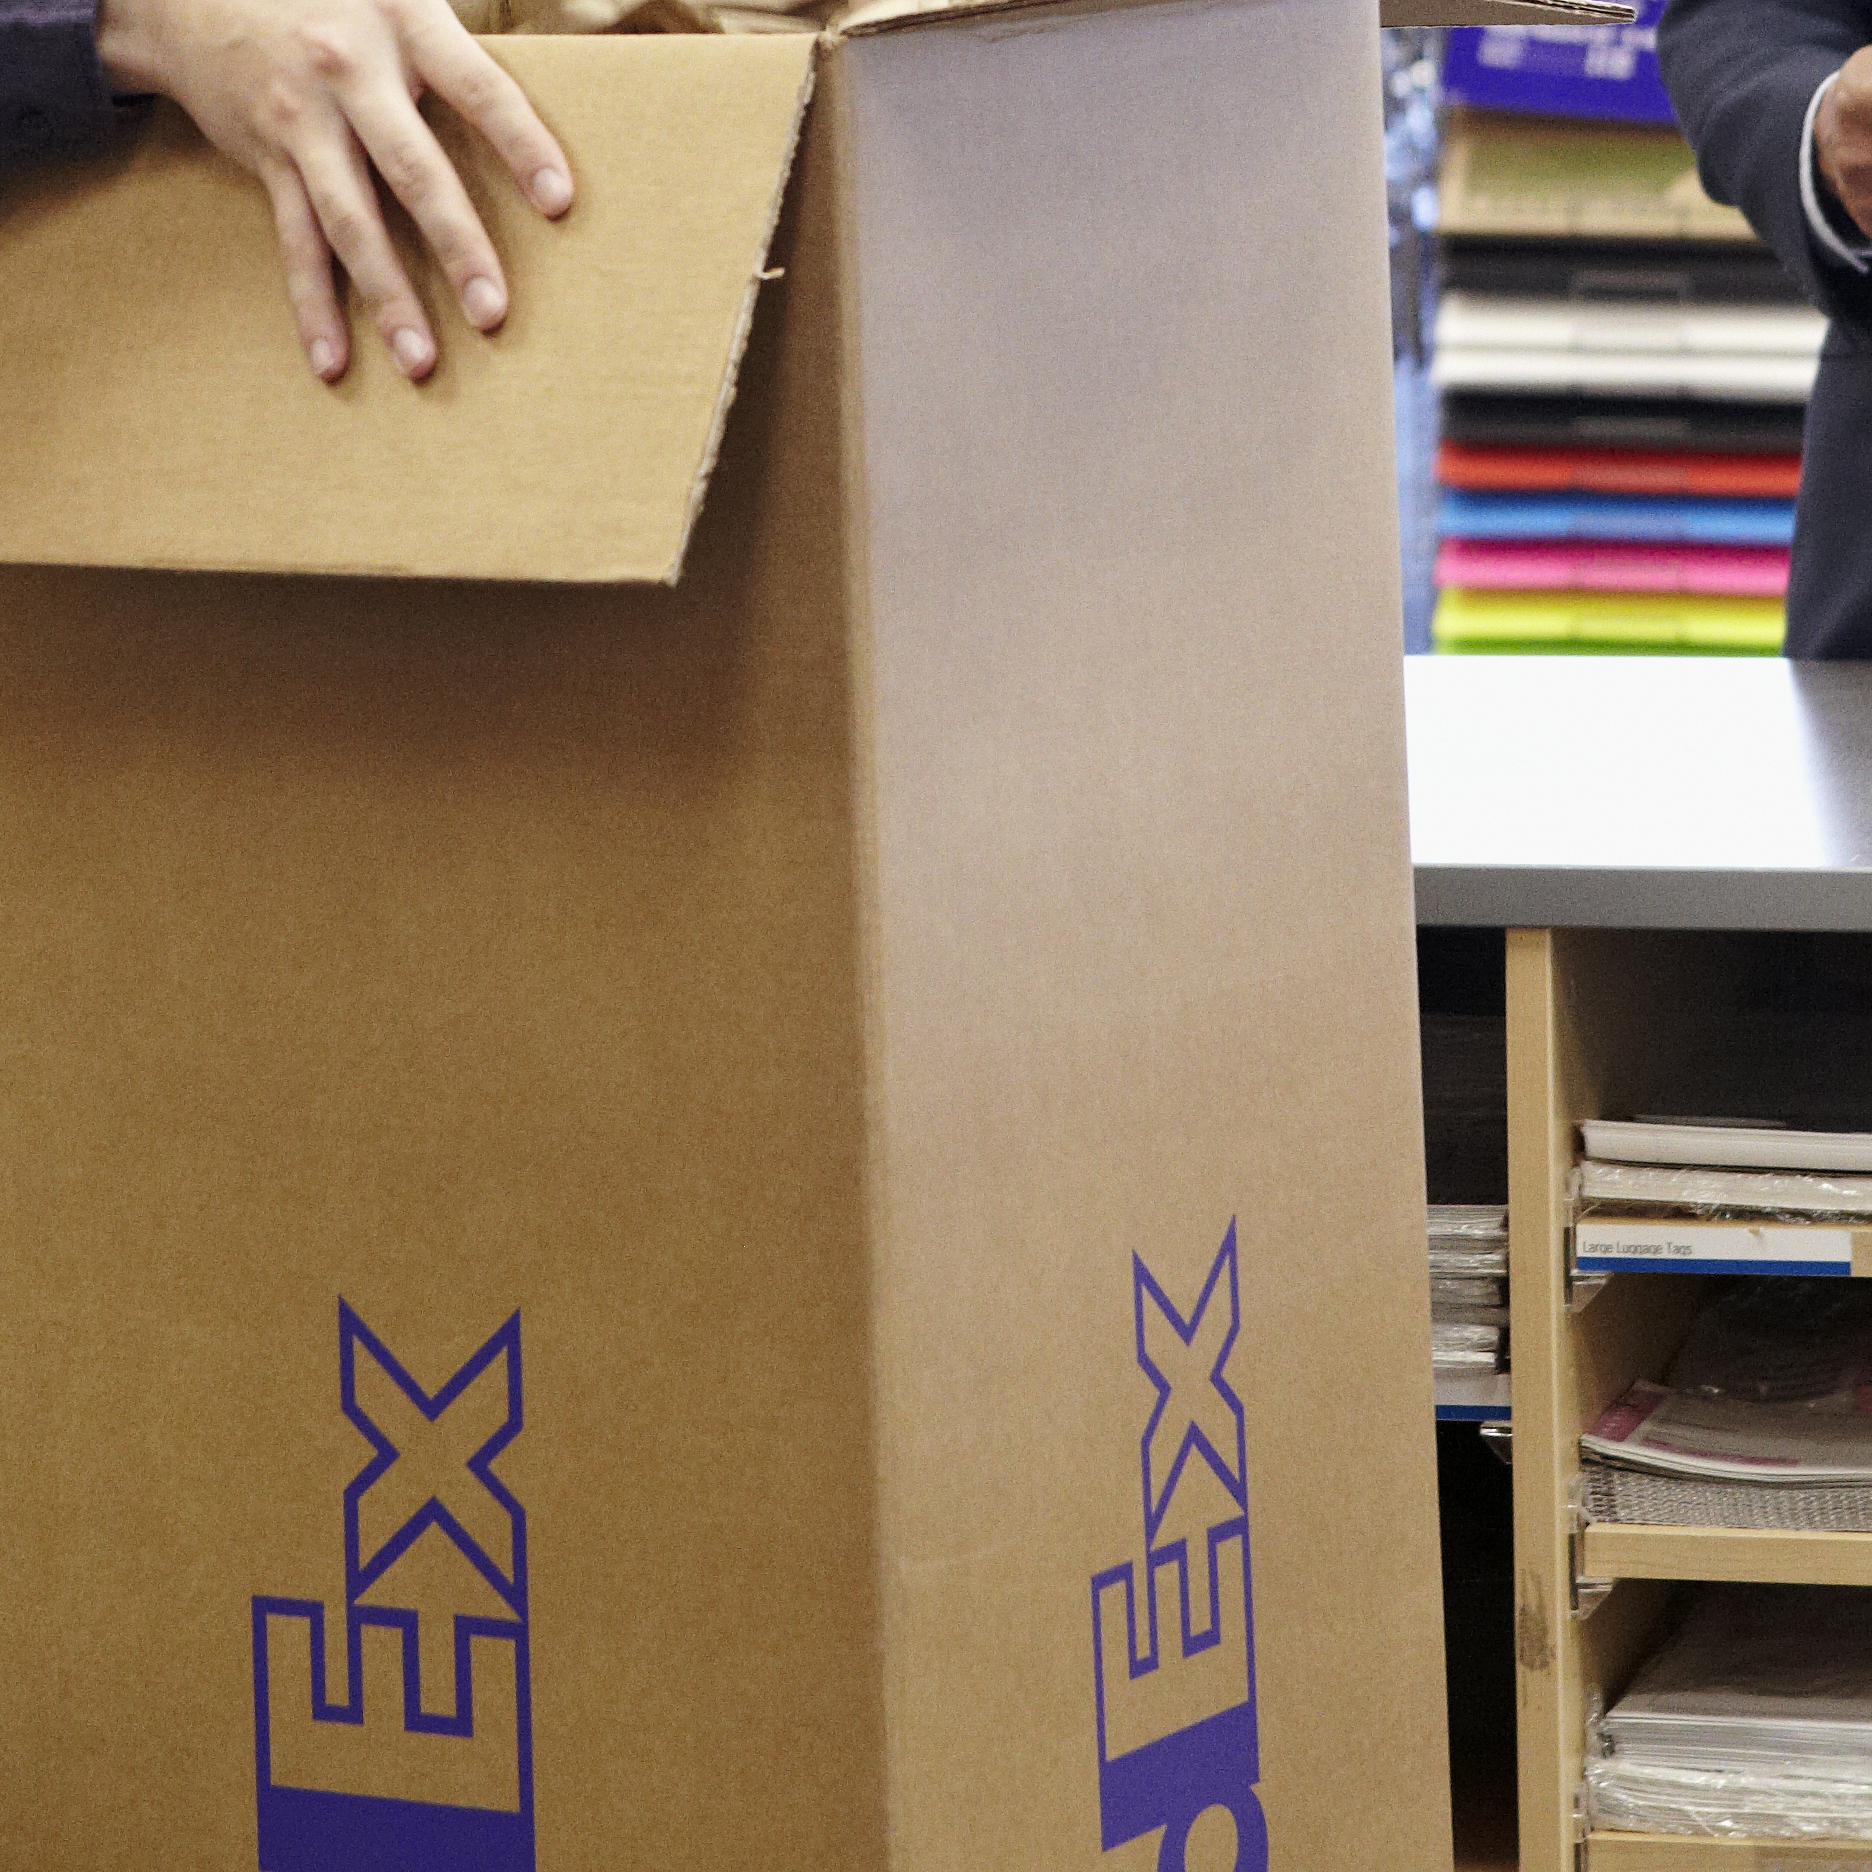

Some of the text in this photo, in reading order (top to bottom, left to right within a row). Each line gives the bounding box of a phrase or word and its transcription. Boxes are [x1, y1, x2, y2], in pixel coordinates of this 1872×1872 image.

[1582, 1240, 1693, 1256] Large Luggage Tags
